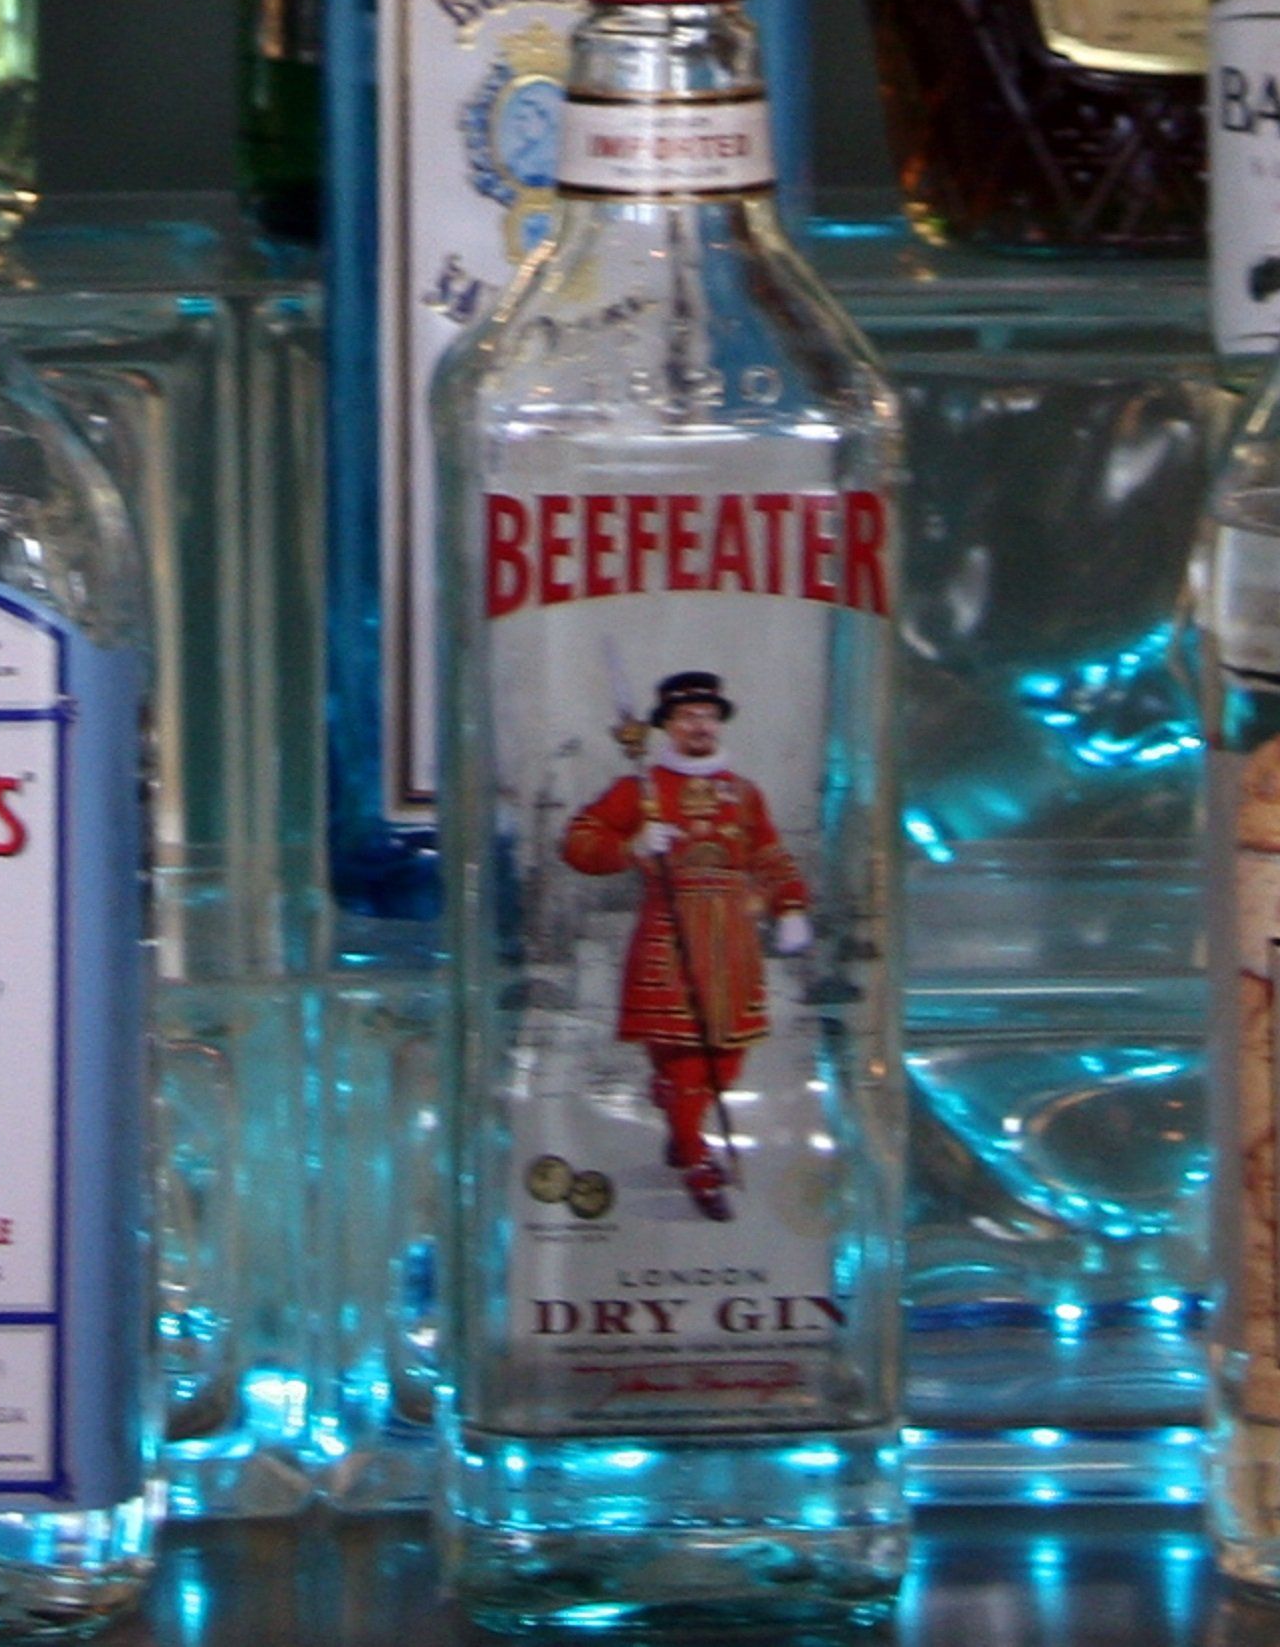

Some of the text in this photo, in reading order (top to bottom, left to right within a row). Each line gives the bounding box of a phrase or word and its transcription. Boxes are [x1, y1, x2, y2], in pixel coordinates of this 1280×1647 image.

[485, 489, 892, 619] BEEFEATER
[530, 1295, 856, 1337] DRY GIN
